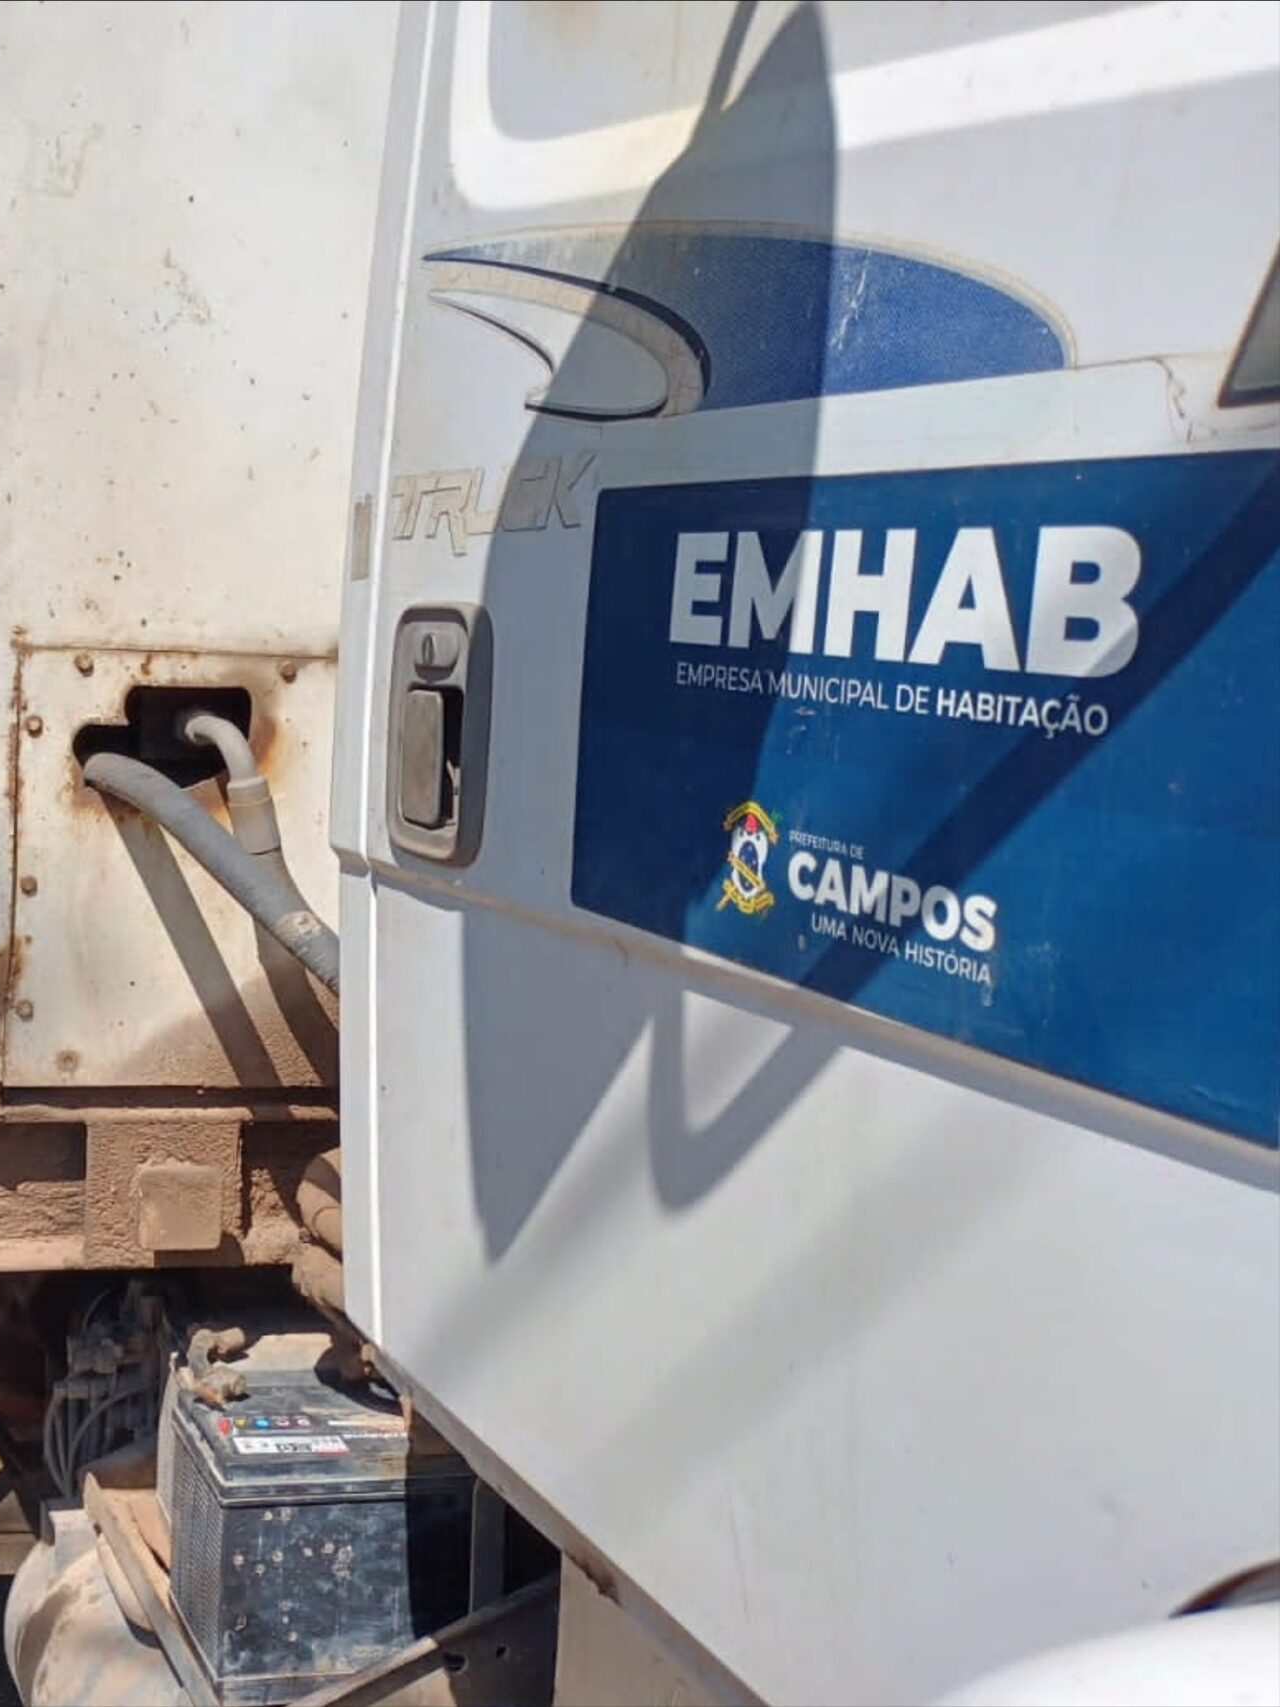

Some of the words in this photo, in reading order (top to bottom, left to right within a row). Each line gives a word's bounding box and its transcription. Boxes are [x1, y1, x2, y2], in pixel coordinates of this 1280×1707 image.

[669, 525, 1142, 678] EMHAB
[676, 661, 763, 694] EMPRESA
[768, 670, 890, 712] MUNICIPAL
[895, 683, 931, 715] DE
[935, 687, 1109, 739] HABITAÇÃO
[789, 830, 847, 855] PREFEITURA
[849, 843, 864, 860] DE
[787, 850, 998, 952] CAMPOS
[811, 913, 847, 941] UMA
[852, 926, 899, 959] NOVA
[904, 939, 992, 987] HISTÓRIA
